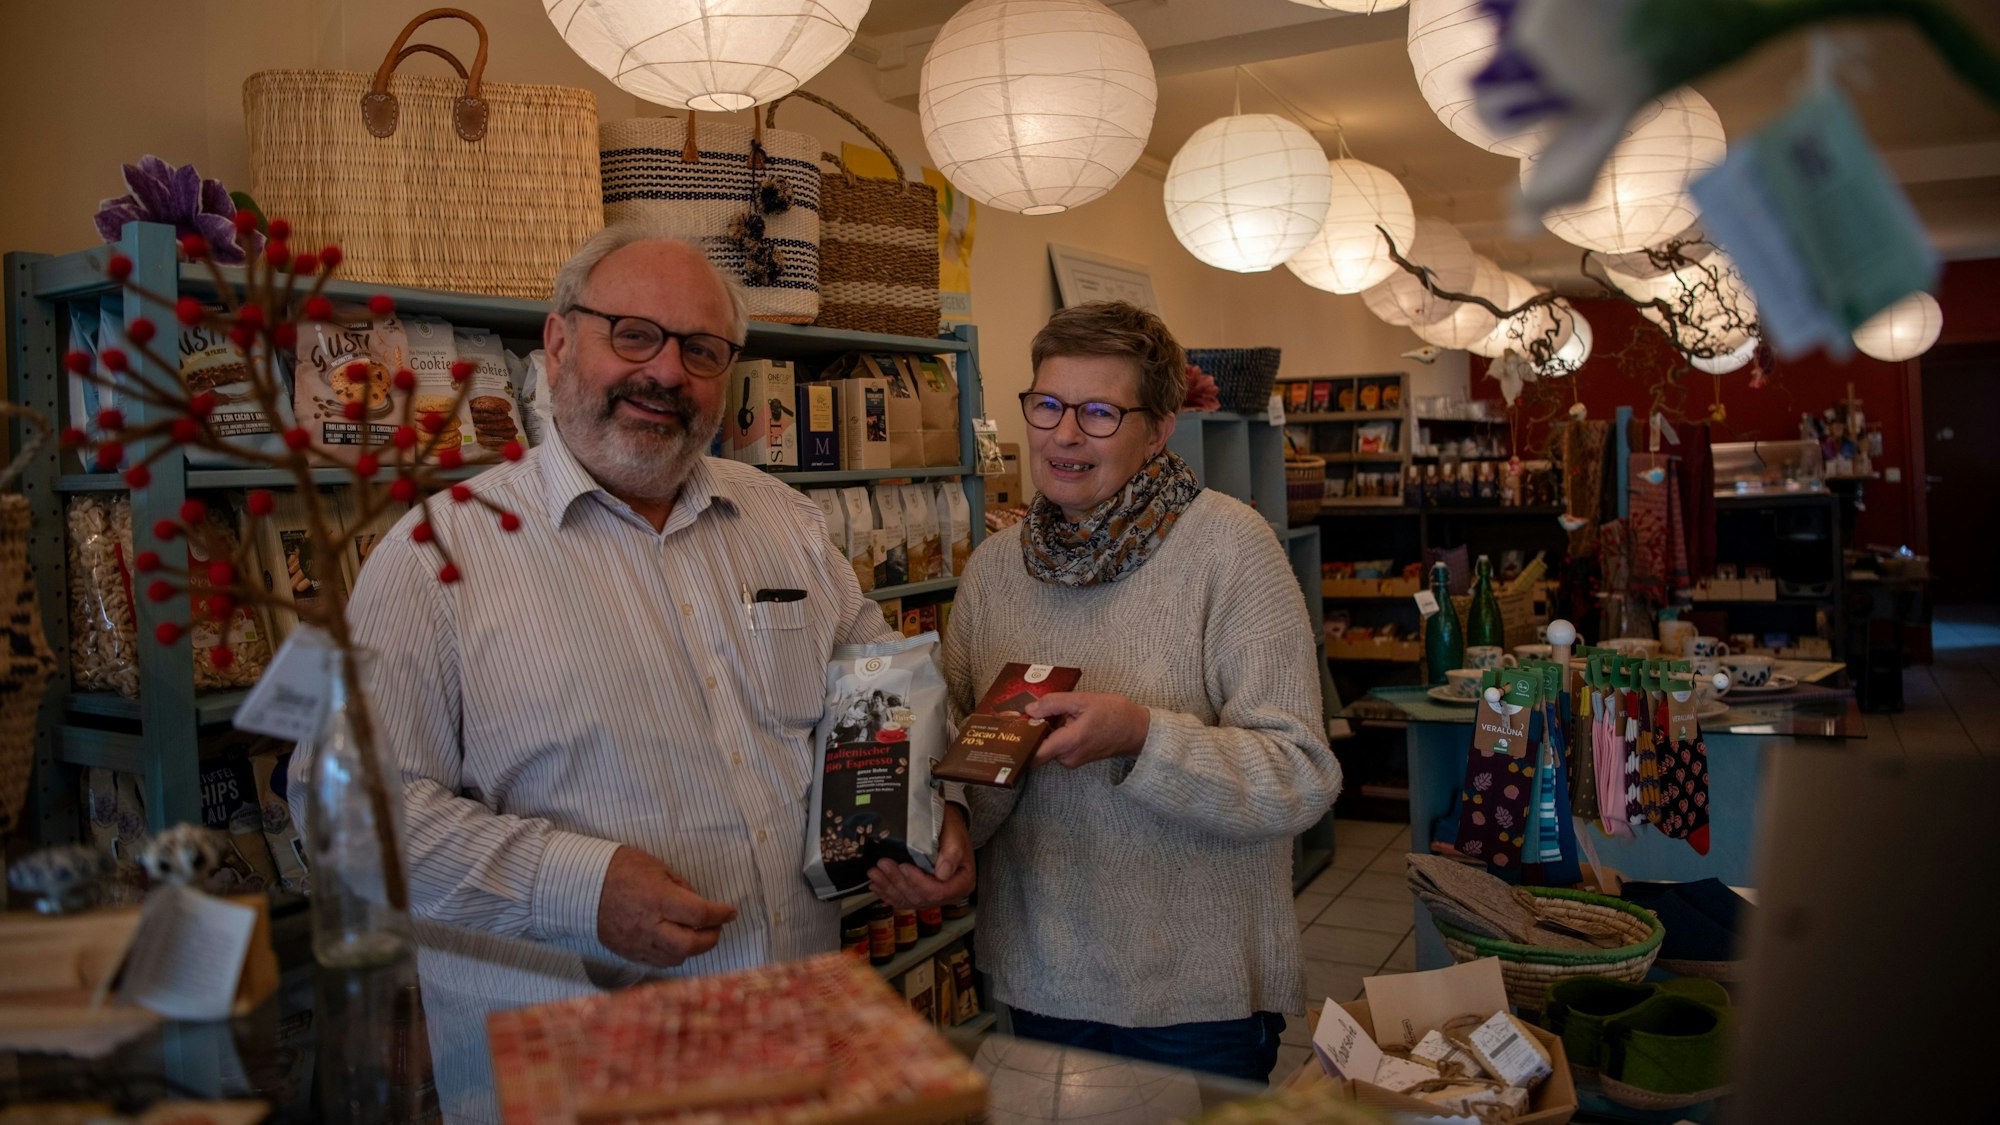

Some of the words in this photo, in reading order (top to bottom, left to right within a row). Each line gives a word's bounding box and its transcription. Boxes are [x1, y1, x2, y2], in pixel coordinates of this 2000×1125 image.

[475, 362, 509, 377] ookies
[769, 418, 784, 463] SET
[966, 729, 996, 739] Cacao
[997, 731, 1022, 743] Nibs
[1481, 723, 1524, 738] VERALUNA
[961, 736, 985, 746] 70%
[826, 746, 892, 762] Italienischer
[845, 757, 894, 769] Espresso
[200, 778, 240, 808] HIPS
